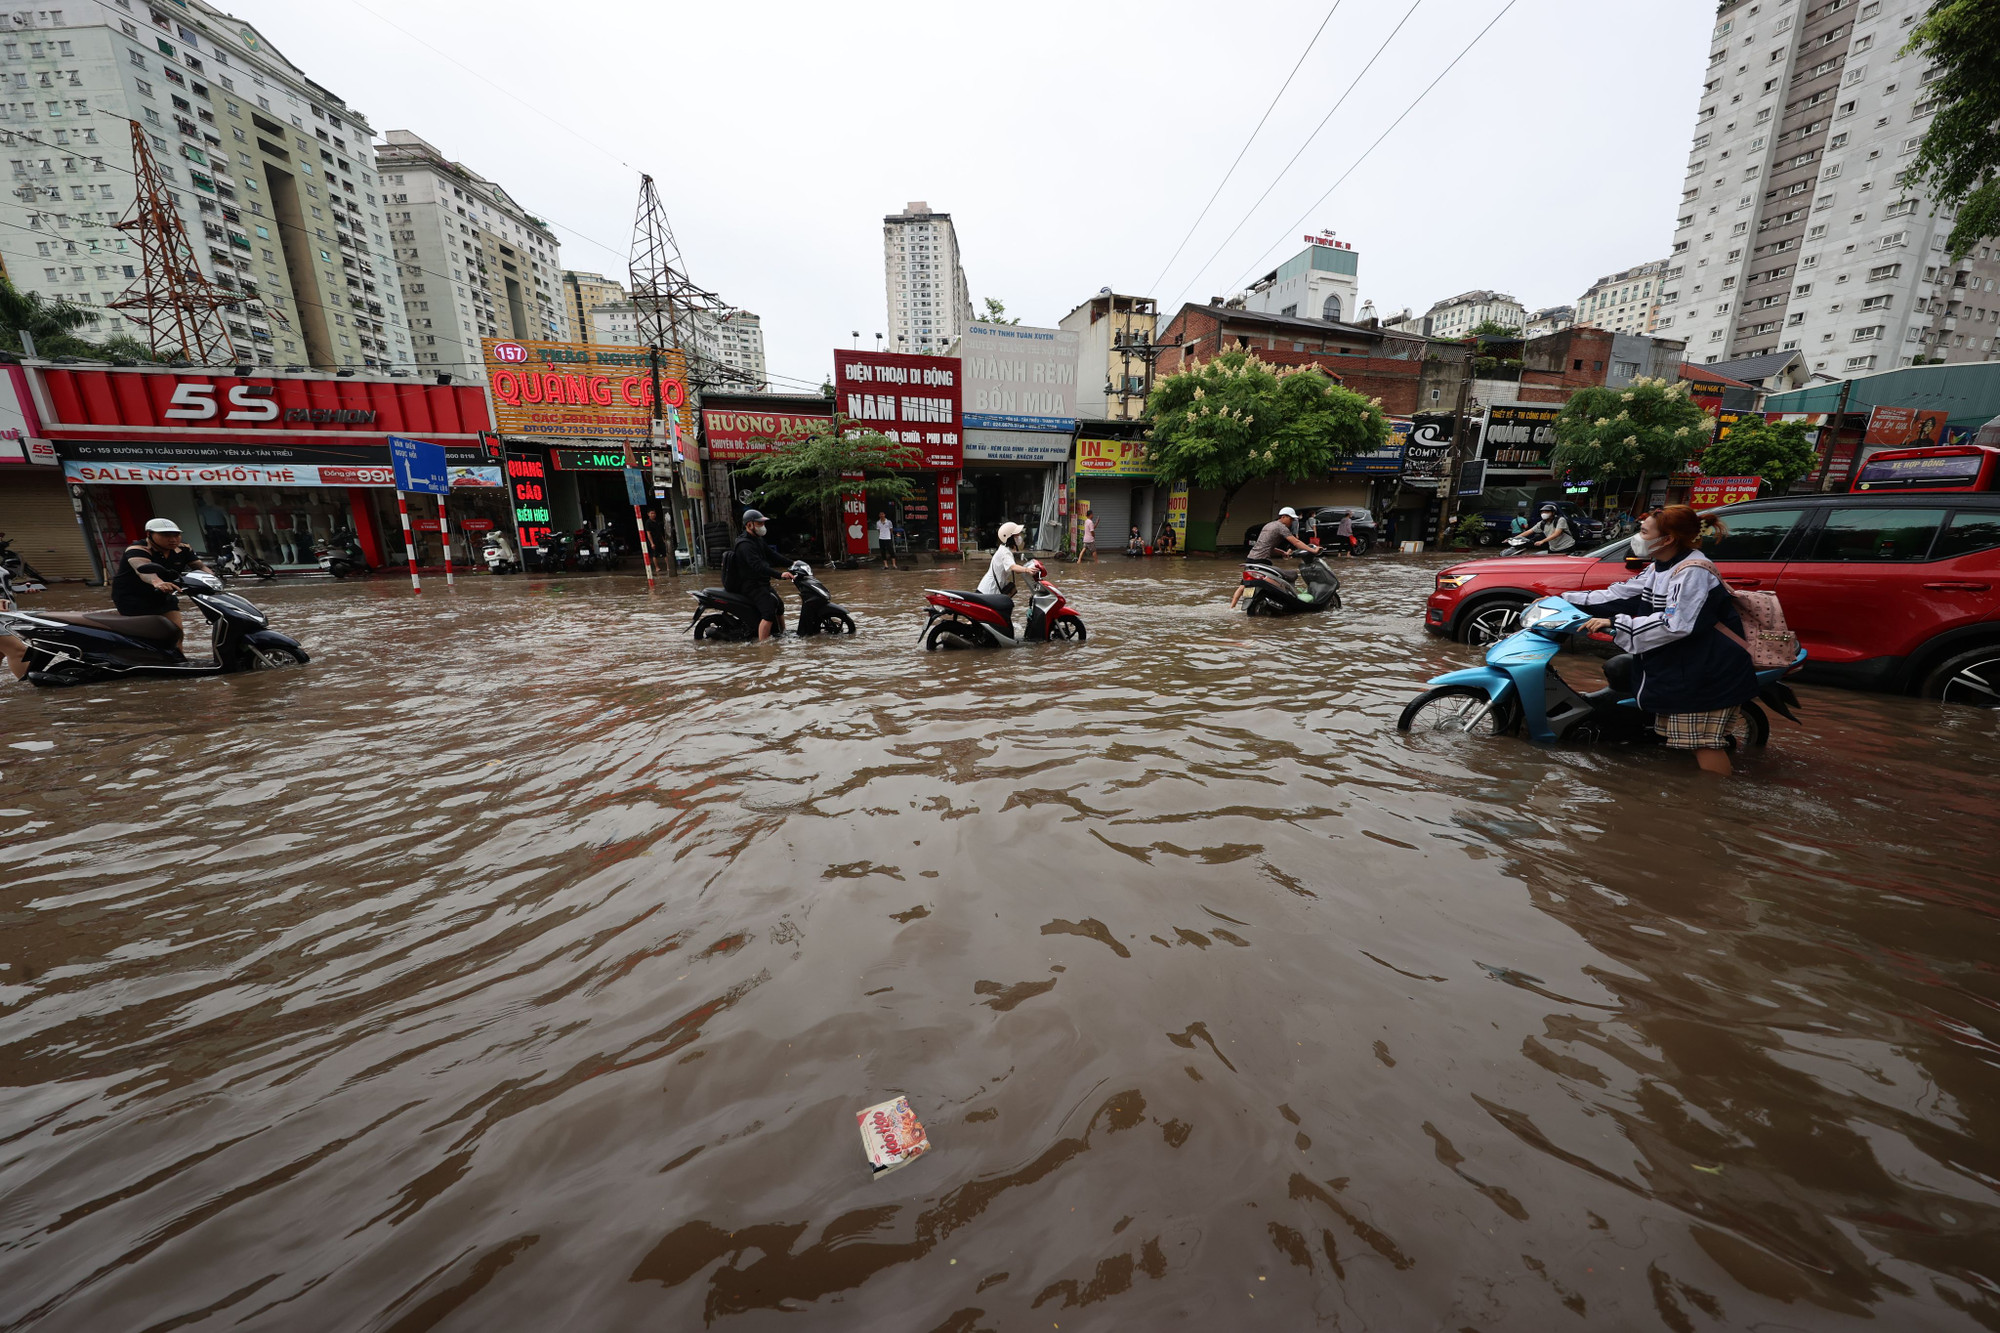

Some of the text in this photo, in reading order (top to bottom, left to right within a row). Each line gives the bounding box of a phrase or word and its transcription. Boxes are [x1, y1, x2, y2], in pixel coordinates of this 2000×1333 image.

[497, 347, 522, 360] 157
[845, 362, 954, 388] ĐIỆN THOẠI DI ĐỘNG
[1033, 358, 1075, 385] RÈM
[492, 362, 613, 407] QUẢNG
[164, 383, 281, 421] 5S
[847, 393, 953, 424] NAM MINH
[1023, 388, 1066, 415] MÙA
[284, 408, 377, 424] FASHION
[707, 413, 776, 433] HƯƠNG
[901, 430, 921, 443] CHỮA
[926, 432, 941, 446] PHỤ
[942, 432, 958, 447] KIỆN
[1487, 420, 1531, 444] QUẢNG
[32, 444, 54, 455] 5S
[113, 446, 143, 454] ĐƯỜNG
[1081, 441, 1101, 457] IN
[508, 454, 543, 478] QUẢNG
[1903, 460, 1921, 468] HỢP
[1921, 459, 1946, 467] ĐỒNG
[80, 465, 295, 482] SALE NỐT CHỐT HÈ
[357, 469, 395, 482] 99K
[516, 481, 543, 500] CÁO
[1691, 493, 1751, 504] XE GA
[844, 499, 866, 516] KIỆN
